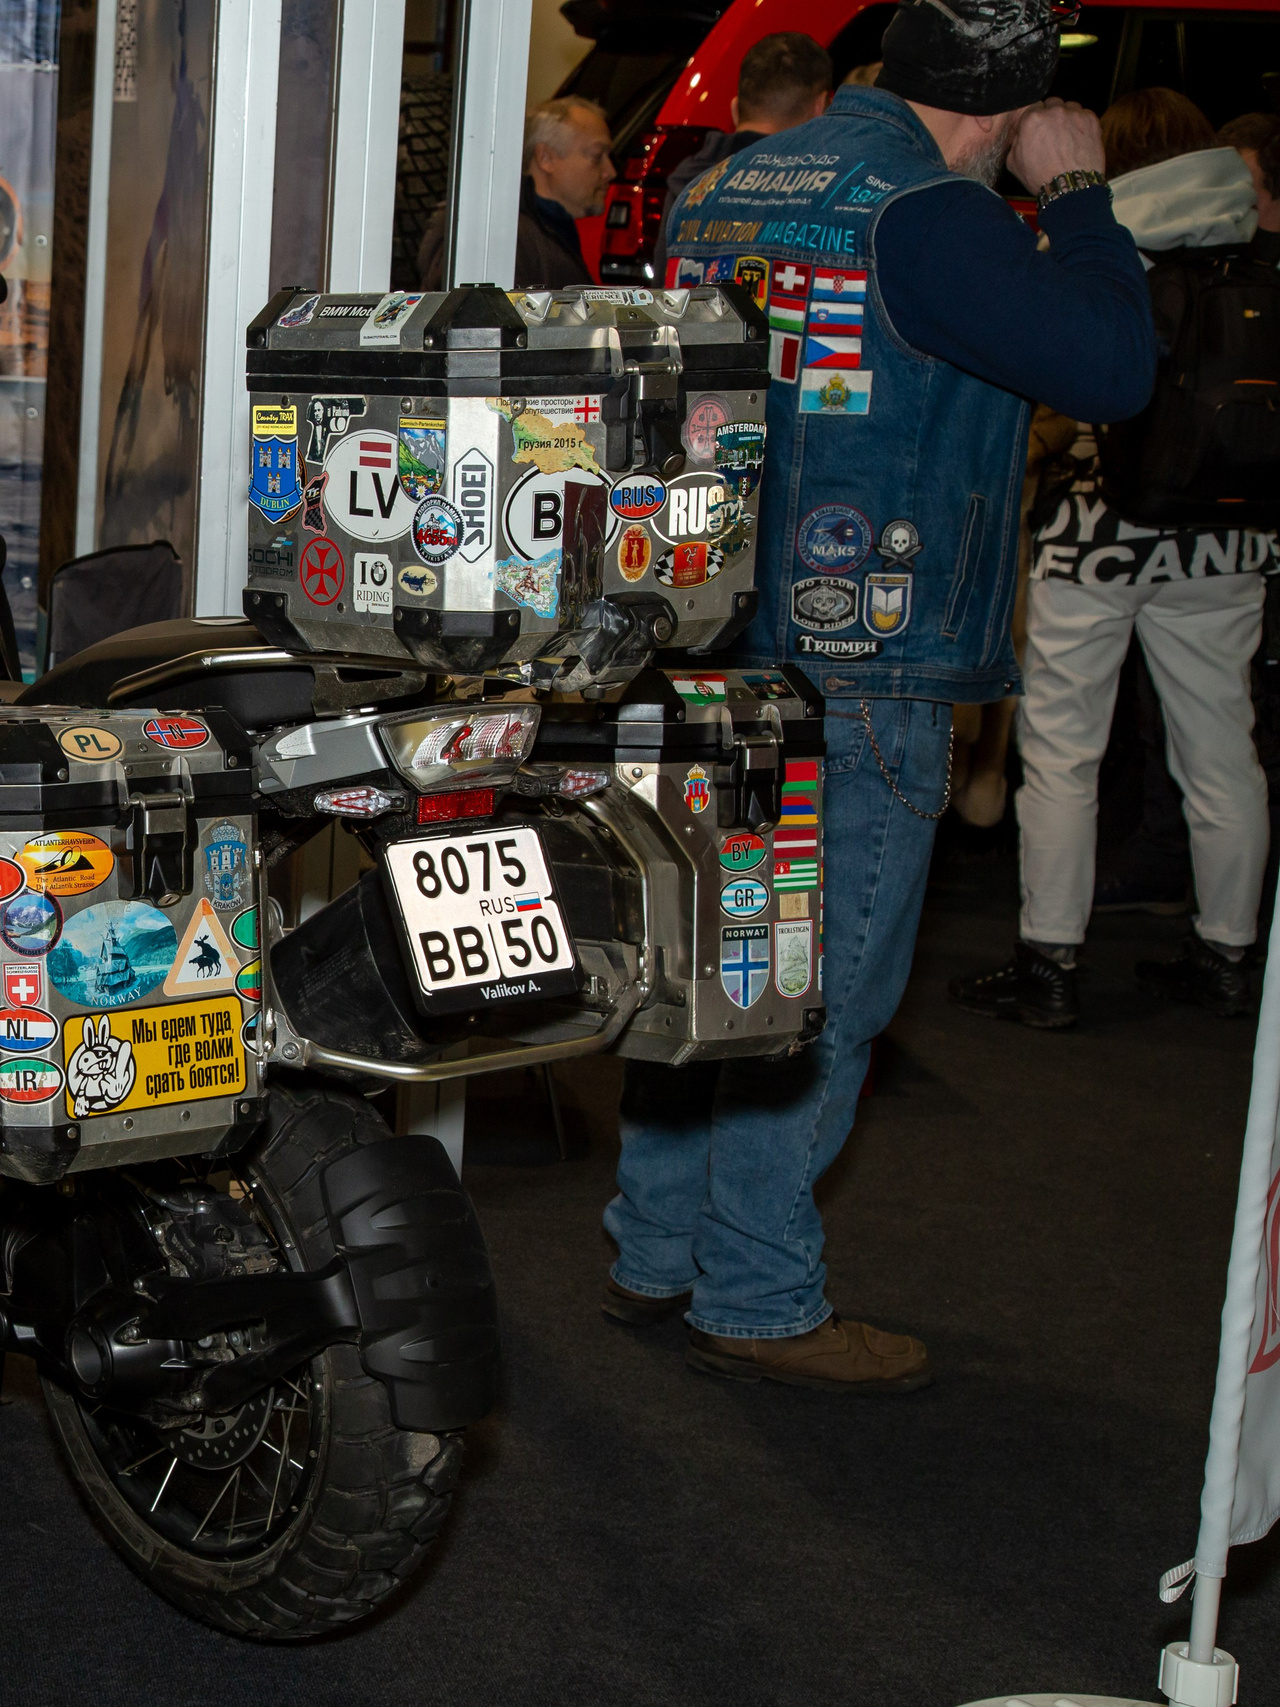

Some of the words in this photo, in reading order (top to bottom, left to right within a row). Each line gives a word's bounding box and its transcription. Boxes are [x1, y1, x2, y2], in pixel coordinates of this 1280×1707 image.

[723, 169, 837, 195] АВИАЦИЯ
[701, 219, 763, 242] AVIATION
[758, 220, 855, 254] MAGAZINE
[320, 306, 348, 317] BMW
[526, 407, 574, 415] опутешествие
[540, 399, 574, 407] просторы
[256, 412, 279, 424] Country
[279, 411, 294, 421] TRAX
[717, 423, 765, 437] AMSTERDAM
[518, 438, 551, 451] Грузия
[554, 438, 576, 449] 2015
[578, 440, 583, 449] г
[260, 496, 290, 509] DUBLIN
[350, 470, 400, 520] LV
[460, 464, 487, 546] SHOEI
[621, 485, 655, 509] RUS
[417, 499, 441, 516] ПОКОРИЛ
[441, 501, 461, 523] ПАМИР
[533, 490, 563, 541] B
[669, 486, 725, 537] RUS
[812, 544, 857, 558] MAKS
[796, 580, 815, 591] NO
[820, 578, 855, 591] CLUB
[356, 590, 390, 603] RIDING
[794, 614, 821, 629] LONE
[823, 614, 857, 630] RIDER
[799, 634, 878, 653] TRIUMPH
[167, 723, 187, 741] N
[74, 733, 111, 753] PL
[731, 841, 752, 862] BY
[412, 838, 527, 899] 8075
[36, 876, 49, 884] The
[50, 882, 73, 890] Atlantik
[74, 881, 95, 889] Strasse
[479, 896, 516, 917] RUS
[734, 888, 755, 908] GR
[725, 928, 766, 939] NORWAY
[778, 926, 810, 935] TROLLSTIGEN
[419, 925, 490, 982] BB
[501, 915, 559, 968] 50
[90, 986, 142, 1007] NORWAY
[480, 982, 526, 1000] Valikov
[528, 979, 541, 993] A.
[6, 1017, 35, 1041] NL
[131, 1018, 157, 1045] Мы
[161, 1015, 196, 1042] едем
[200, 1010, 235, 1038] туда,
[167, 1042, 191, 1068] где
[195, 1036, 234, 1061] волки
[15, 1069, 38, 1092] IR
[146, 1070, 185, 1099] срать
[189, 1058, 240, 1090] боятся!
